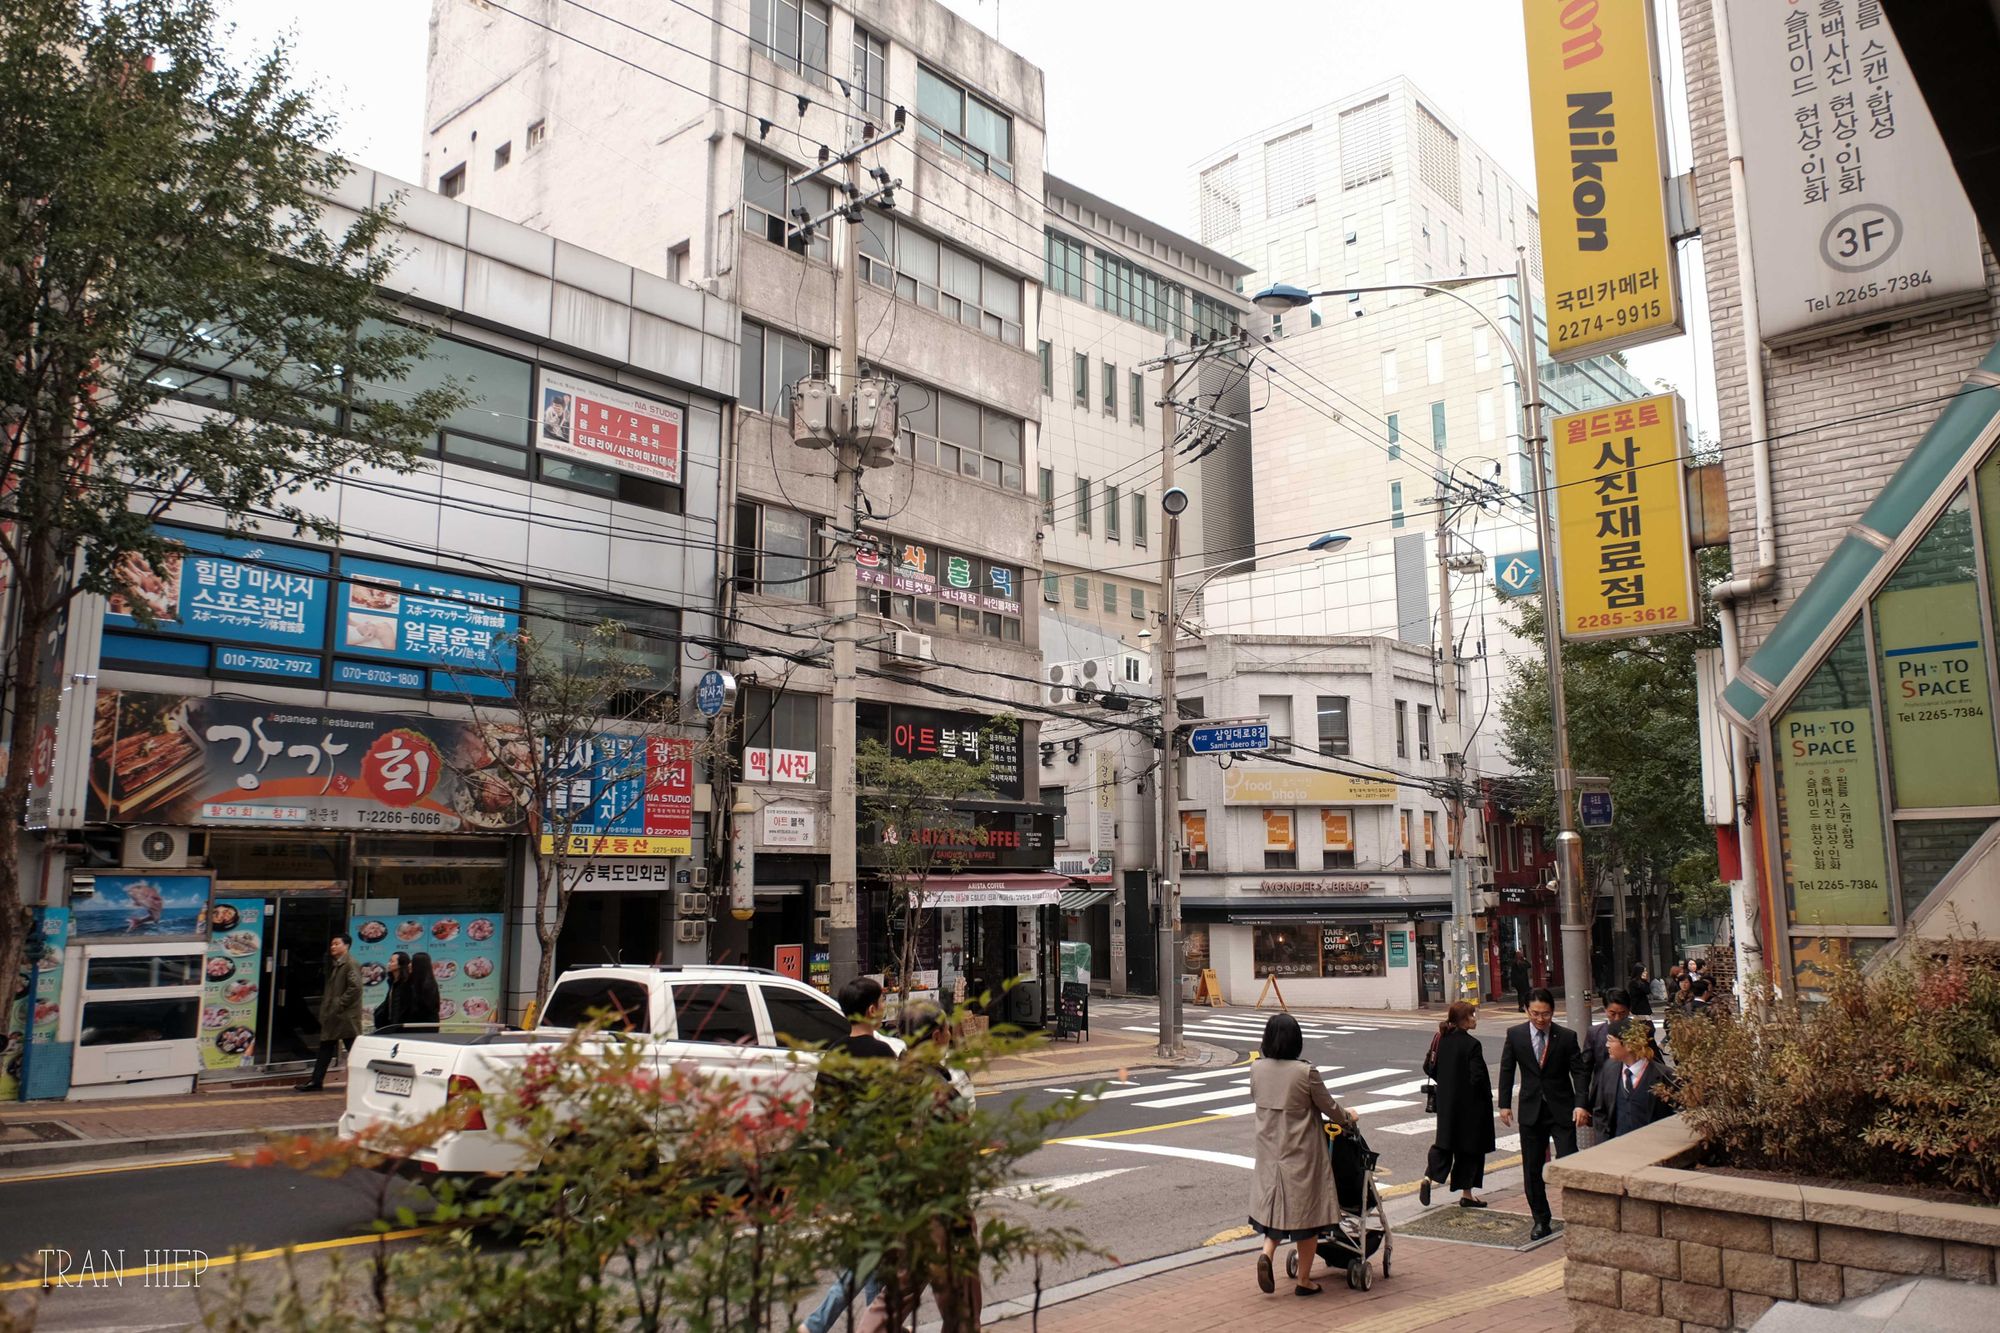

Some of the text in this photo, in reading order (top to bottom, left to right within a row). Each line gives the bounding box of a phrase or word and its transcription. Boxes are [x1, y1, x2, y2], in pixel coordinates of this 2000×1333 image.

[1560, 0, 1604, 71] on
[1855, 0, 1896, 140] 름 스캔·합성
[1783, 8, 1829, 205] 슬라이드 현상·인화
[1819, 0, 1866, 195] 흑백사진 현상·인화
[1566, 91, 1618, 252] Nikon
[1836, 217, 1886, 259] 3F
[1556, 268, 1660, 313] 국민카메라
[1804, 270, 1933, 314] Tel 2265-7384
[1558, 300, 1661, 343] 2274-9915
[634, 401, 679, 420] NA STUDIO
[1567, 403, 1660, 445] 월드포토
[1593, 436, 1646, 609] 사진재료점
[195, 560, 315, 600] 힐링 마사지
[191, 588, 305, 623] 스포츠관리
[1577, 605, 1678, 629] 2285-3612
[404, 620, 492, 650] 얼굴윤곽
[223, 653, 313, 674] 010-7502-7972
[342, 666, 419, 686] 070-8703-1800
[700, 685, 724, 699] 마사지
[1901, 678, 1972, 698] SPACE
[268, 712, 374, 730] Japanese Restaurant
[1897, 707, 1984, 722] Tel 2265-7384
[1210, 739, 1267, 750] Samil-daero 8-gil
[1214, 726, 1266, 741] 삼일대로8길
[1792, 739, 1857, 757] SPACE
[375, 736, 430, 796] 회
[654, 766, 686, 787] 사진
[777, 754, 809, 778] 사진
[1244, 779, 1273, 792] food
[1271, 788, 1308, 800] photo
[1836, 775, 1848, 798] 필름
[661, 794, 691, 803] STUDIO
[1807, 777, 1820, 819] 슬라이드
[1822, 776, 1836, 819] 흑백사진
[357, 810, 441, 825] T:2266-6066
[584, 864, 667, 882] 충북도민회관
[1261, 880, 1370, 894] WONDER BREAD
[1798, 879, 1878, 891] Tel 2265-7384
[1324, 928, 1344, 936] TAKE
[1324, 936, 1341, 944] OUT
